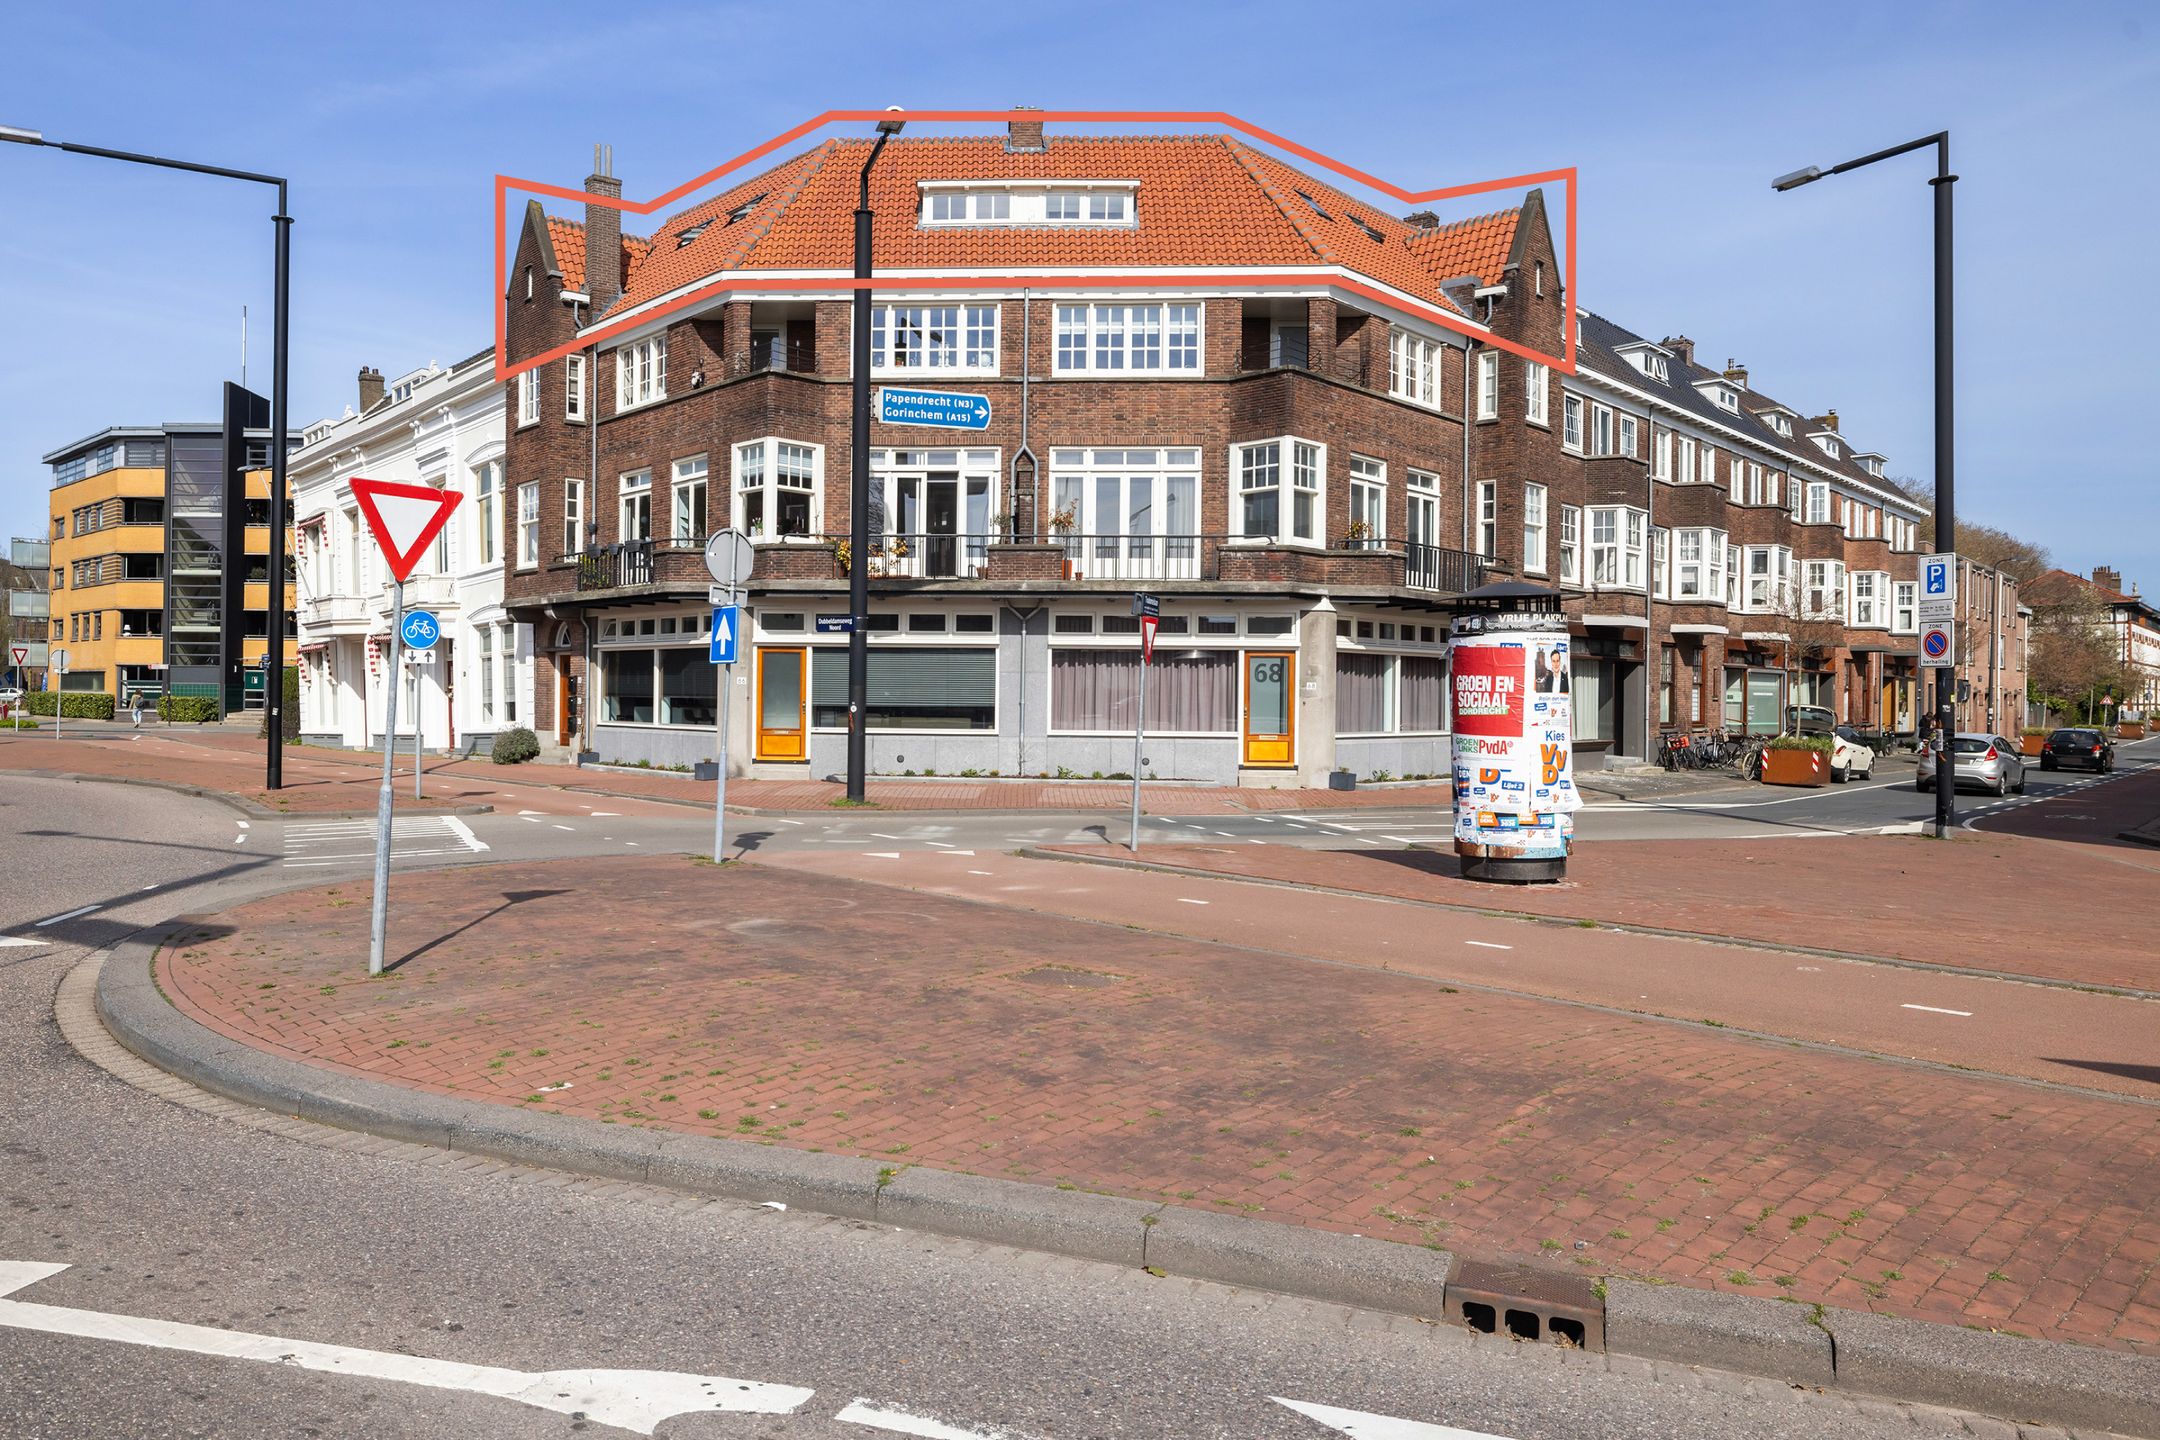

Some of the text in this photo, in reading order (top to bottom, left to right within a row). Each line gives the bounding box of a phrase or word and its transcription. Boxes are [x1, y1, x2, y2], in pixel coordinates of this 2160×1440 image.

[885, 392, 974, 409] Papendrecht (N3)
[884, 406, 971, 423] Gorinchem (A15)
[1498, 613, 1530, 623] VRIJE
[1254, 662, 1281, 683] 68
[1456, 675, 1515, 693] GROEN EN
[1458, 692, 1510, 708] SOCIAAL
[1459, 707, 1508, 715] DORDRECHT
[1455, 737, 1479, 747] GROEN
[1545, 730, 1566, 742] Kies
[1479, 739, 1508, 755] PvdA
